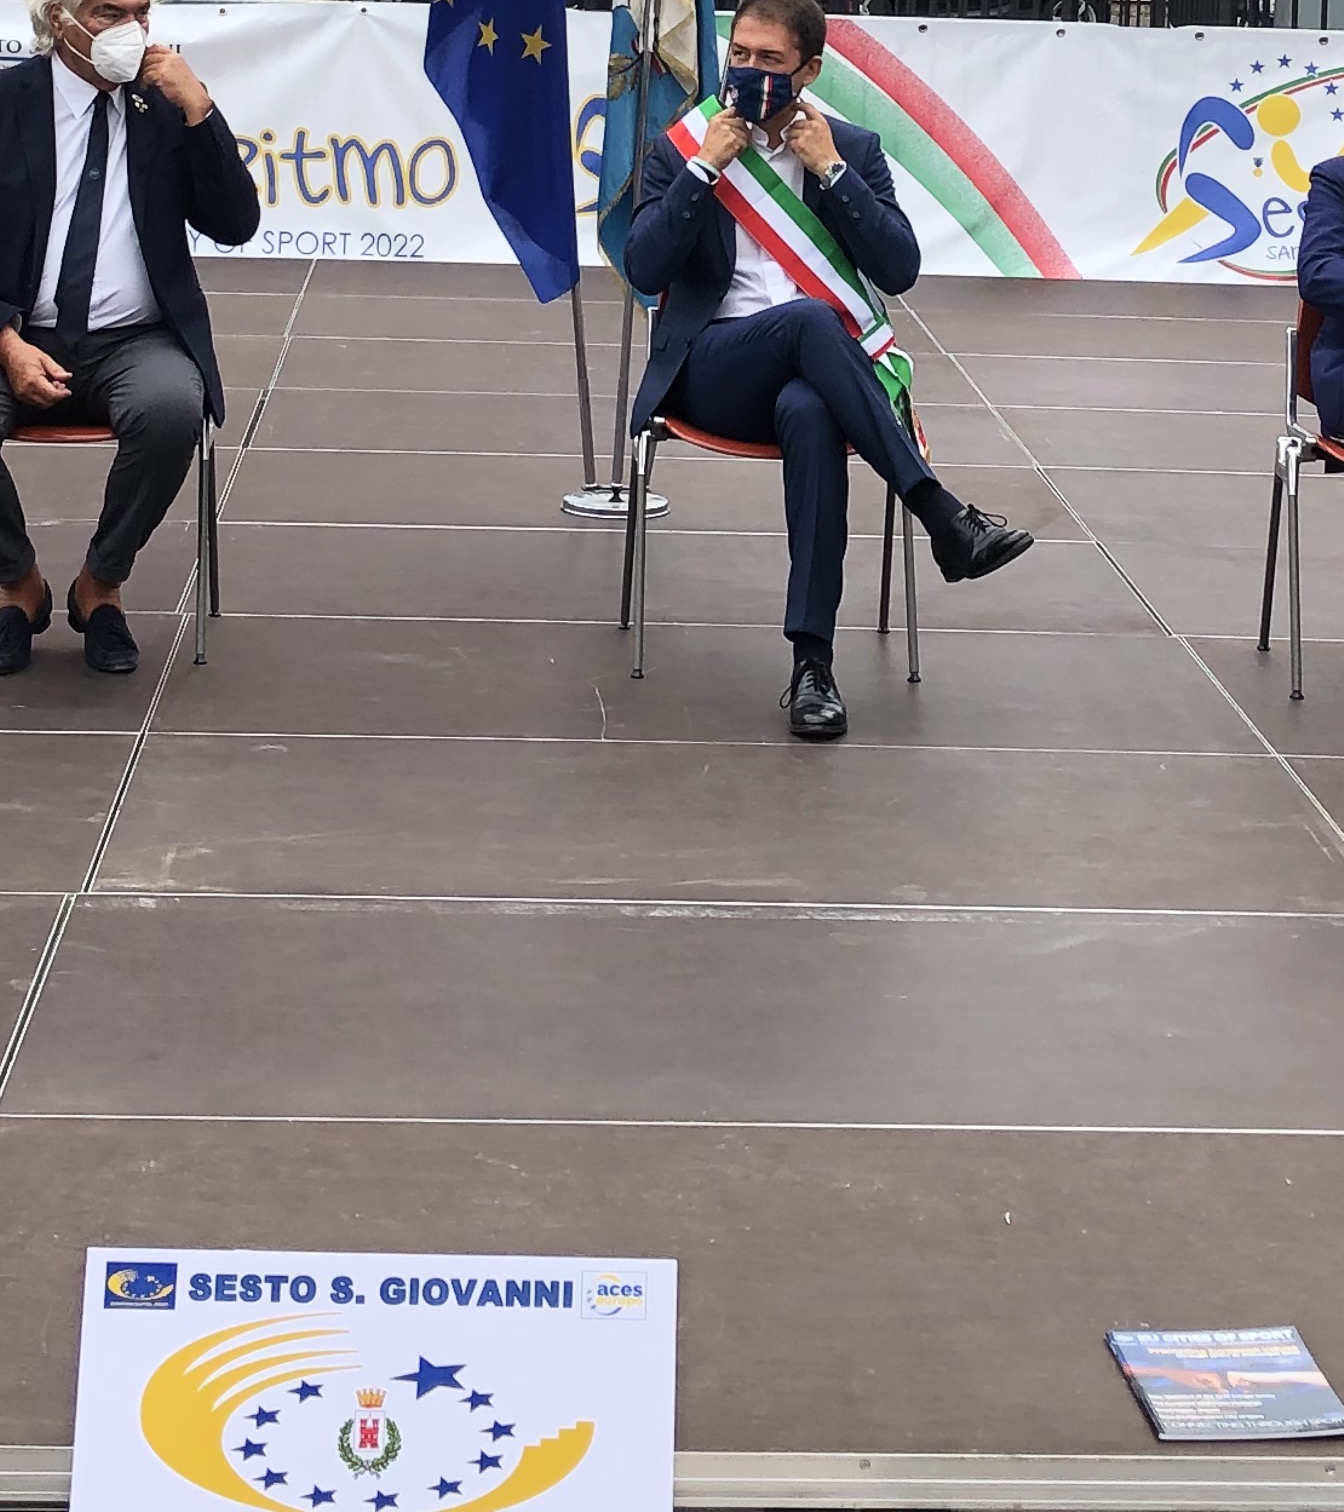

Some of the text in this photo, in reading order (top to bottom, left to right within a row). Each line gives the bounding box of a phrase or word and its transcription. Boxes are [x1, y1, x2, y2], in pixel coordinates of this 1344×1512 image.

[262, 230, 351, 256] SPORT
[360, 233, 425, 258] 2022
[188, 1273, 574, 1309] SESTO S. GIOVANNI
[597, 1284, 643, 1297] aces
